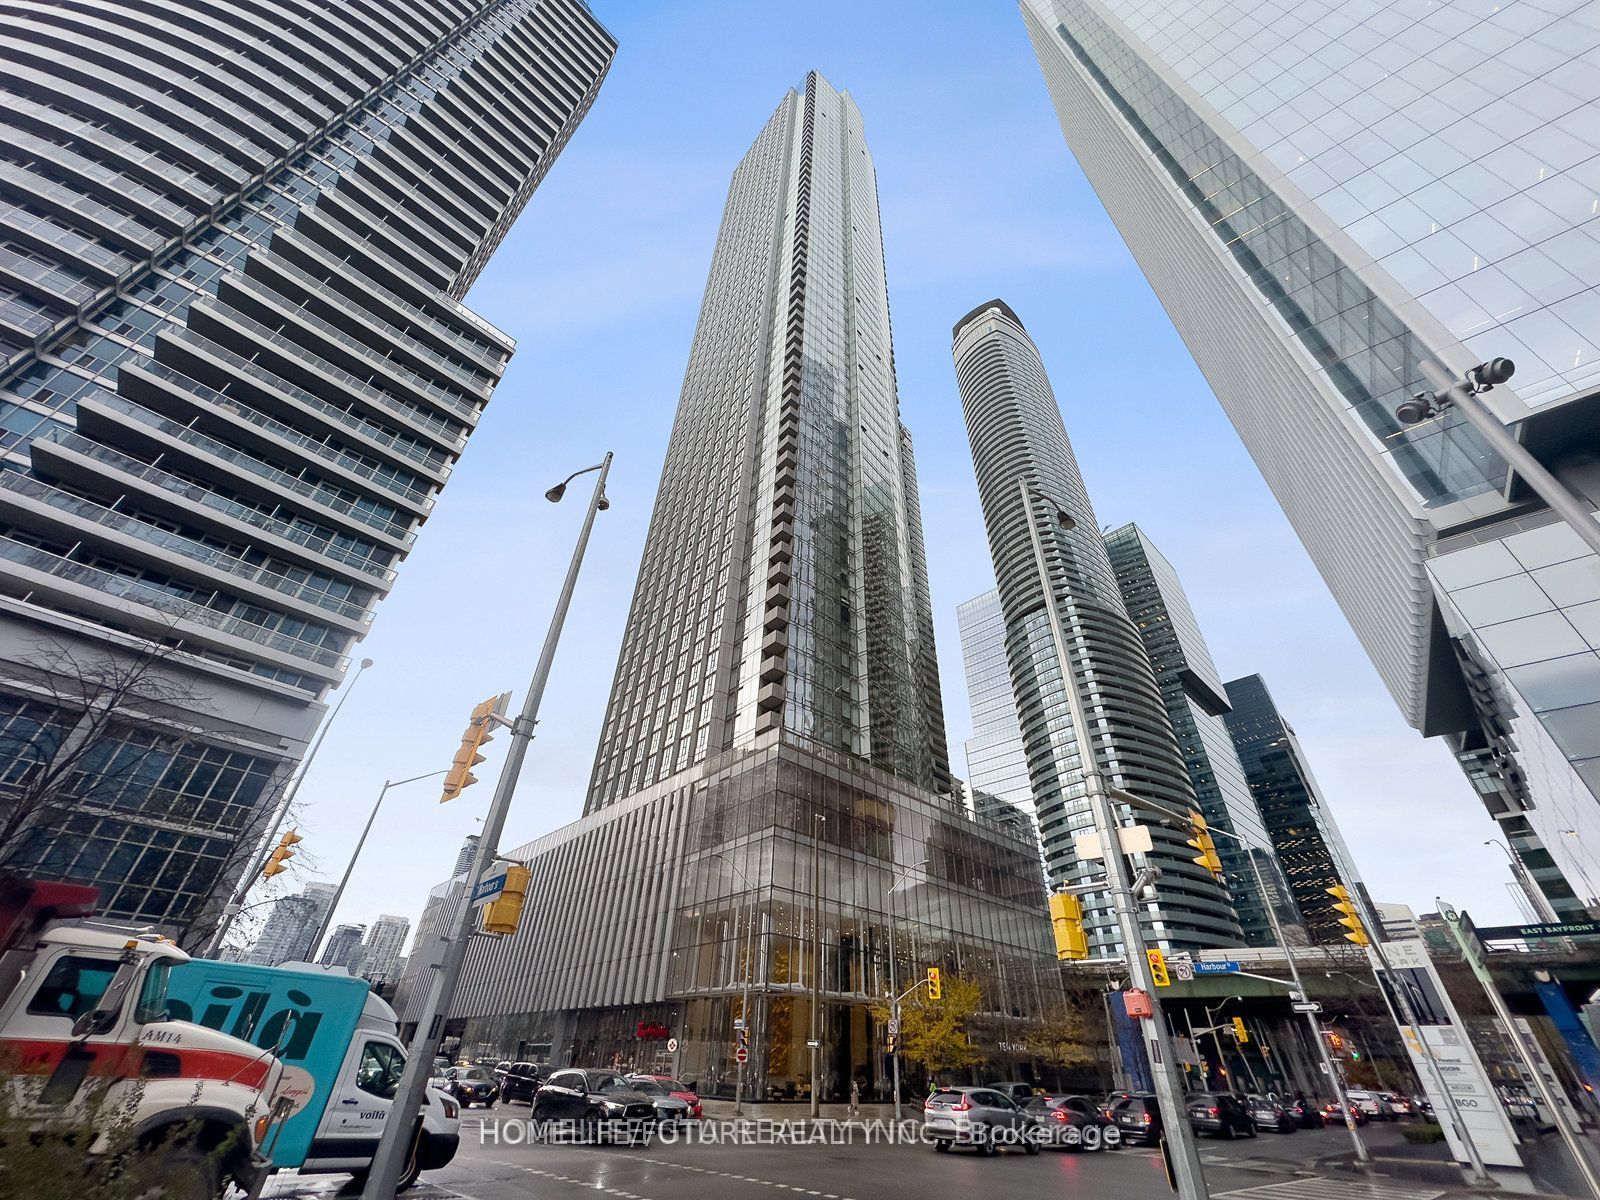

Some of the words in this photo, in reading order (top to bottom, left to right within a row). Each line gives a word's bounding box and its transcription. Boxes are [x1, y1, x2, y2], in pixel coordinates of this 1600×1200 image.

[1545, 924, 1595, 933] BAYFRONT
[1200, 963, 1227, 971] Harbour
[142, 1030, 182, 1044] AM14
[1455, 1098, 1478, 1108] BGO
[360, 1110, 386, 1120] voilà
